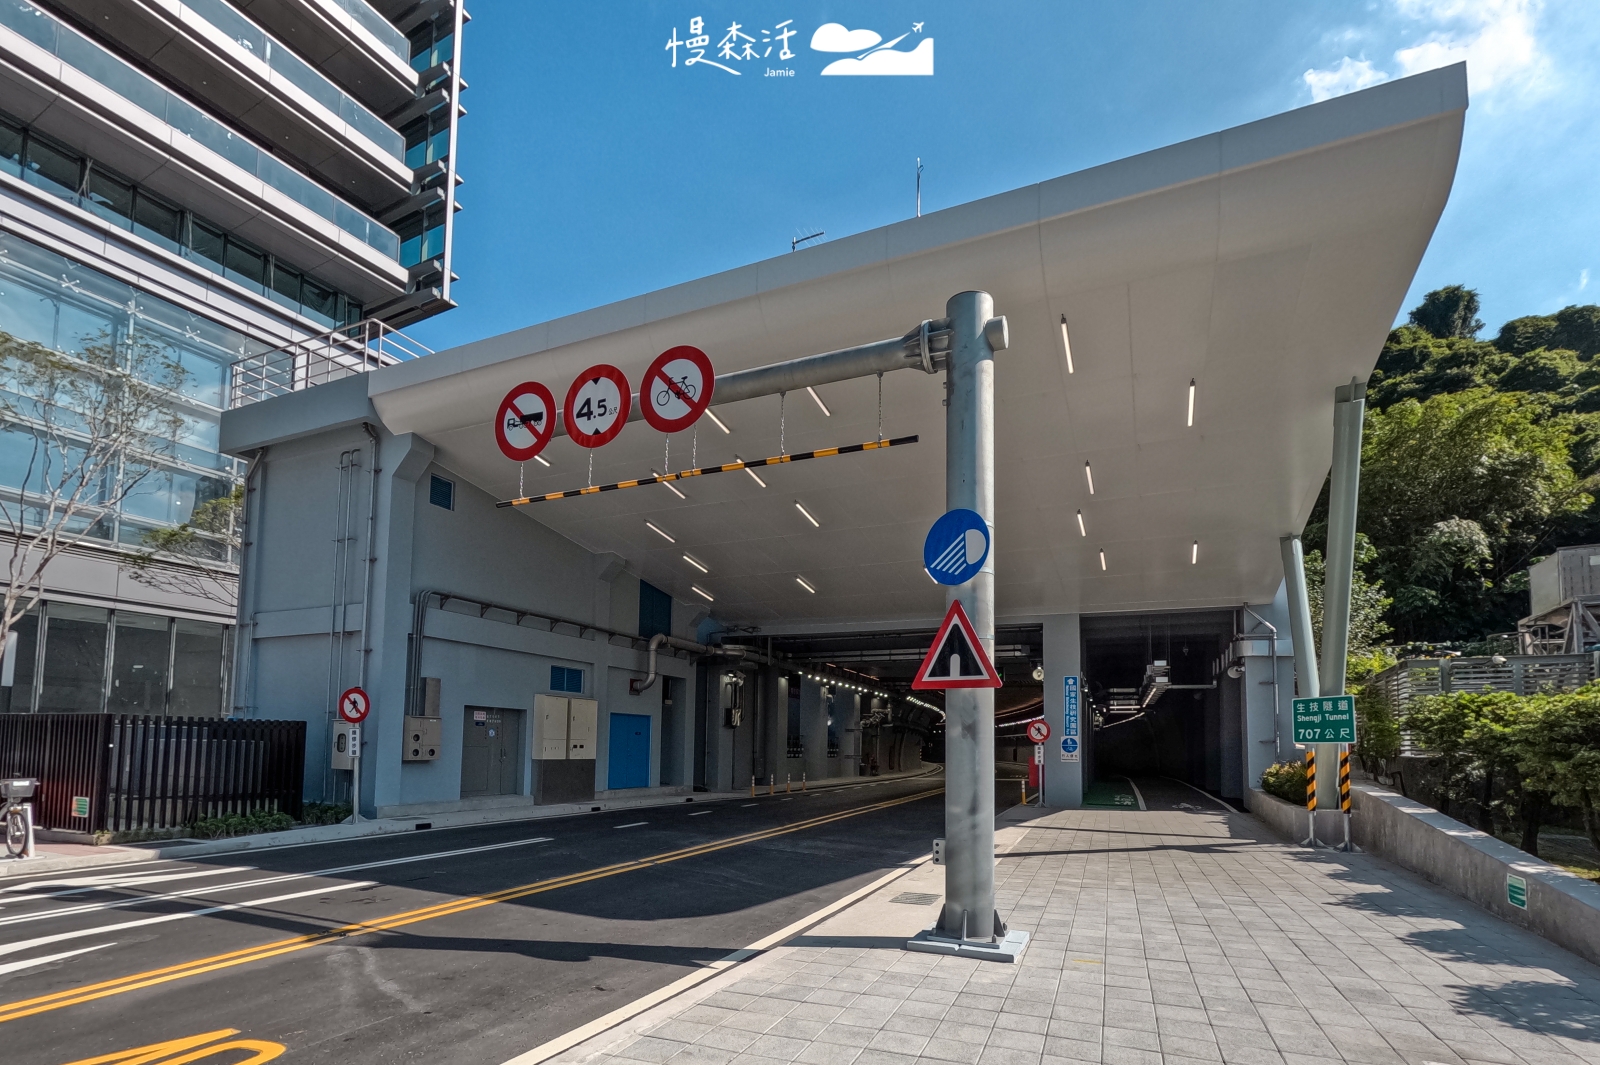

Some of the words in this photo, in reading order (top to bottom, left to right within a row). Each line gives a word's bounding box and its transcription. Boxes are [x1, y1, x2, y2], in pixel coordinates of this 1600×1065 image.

[1296, 700, 1348, 713] 生技隧道
[1297, 714, 1322, 723] Shengji
[1325, 713, 1349, 721] Tunnel
